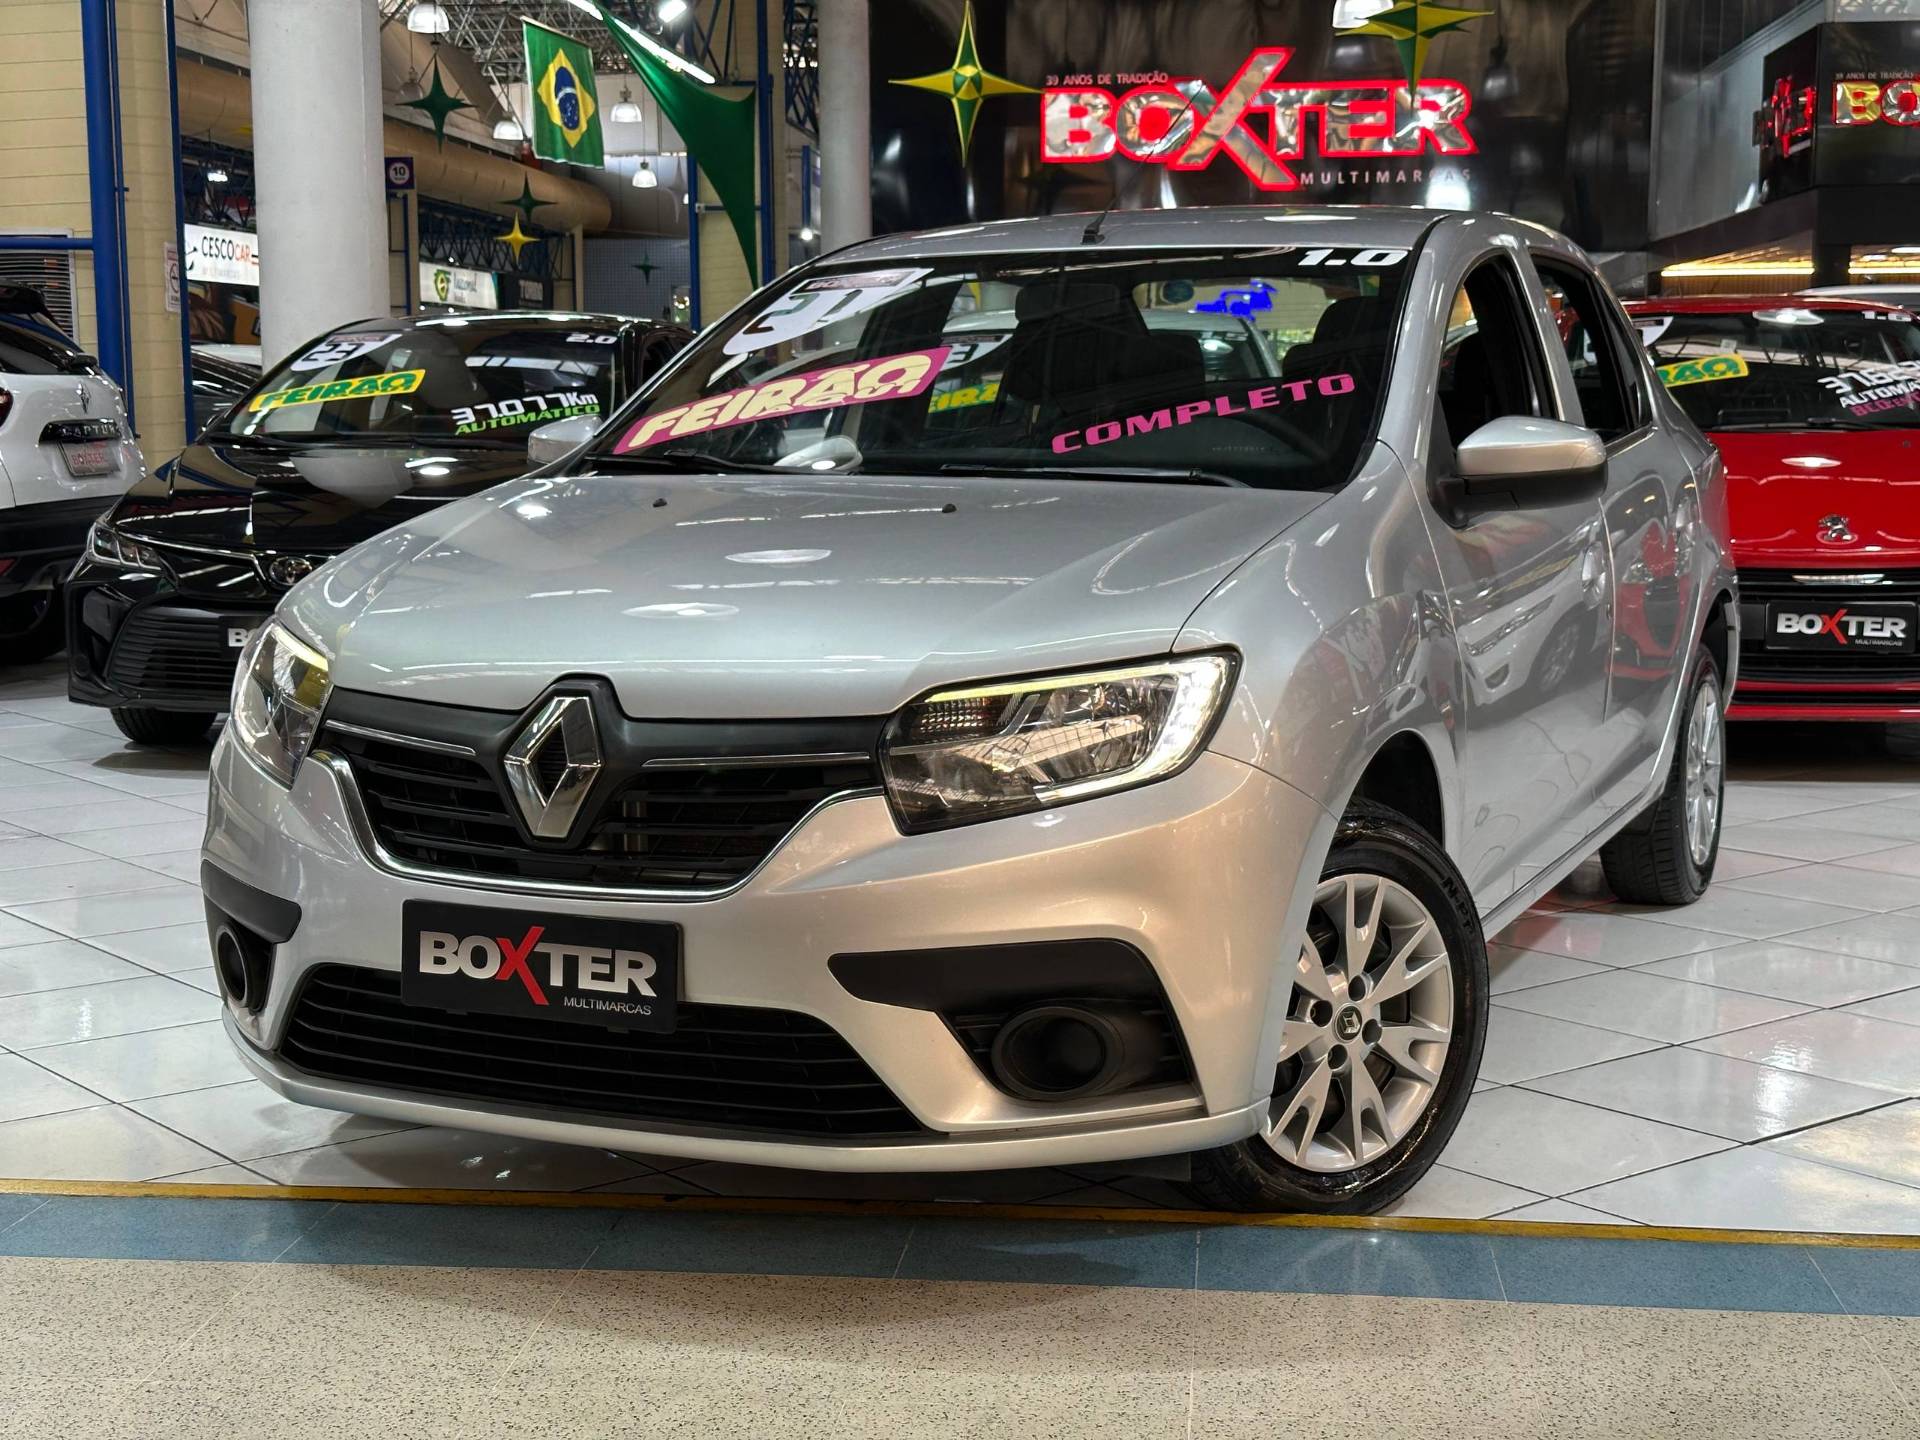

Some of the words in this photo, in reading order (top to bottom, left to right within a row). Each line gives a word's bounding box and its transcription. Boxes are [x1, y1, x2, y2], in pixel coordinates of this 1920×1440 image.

[1045, 75, 1059, 86] 39
[1063, 74, 1093, 85] ANOS
[1097, 74, 1112, 84] DE
[1117, 71, 1168, 84] TRADIÇÃO
[1832, 79, 1920, 127] BO
[1041, 47, 1479, 191] BOXTER
[392, 166, 406, 177] 10
[1297, 249, 1409, 266] 1.0
[302, 342, 365, 362] 23
[565, 333, 618, 345] 2.0
[627, 354, 933, 448] FEIRÃO
[1051, 373, 1356, 454] COMPLETO
[1777, 609, 1907, 645] BOXTER
[419, 926, 658, 1006] BOXTER
[563, 995, 652, 1016] MULTIMARCAS
